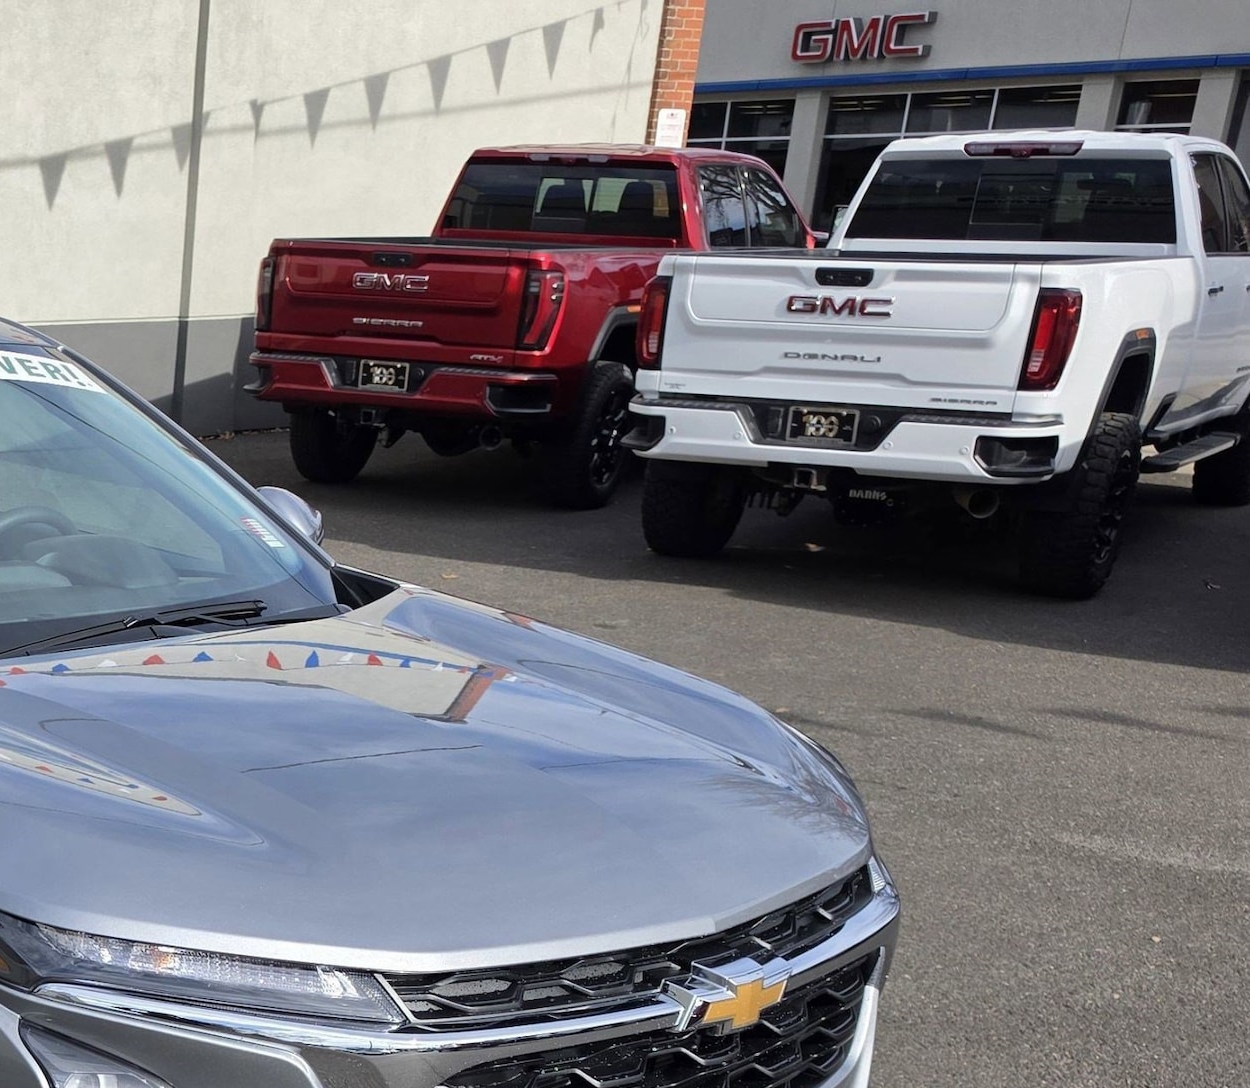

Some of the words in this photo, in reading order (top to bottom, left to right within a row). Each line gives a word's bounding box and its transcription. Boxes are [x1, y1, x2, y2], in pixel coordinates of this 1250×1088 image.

[791, 11, 932, 63] GMC
[353, 272, 429, 292] GMC
[786, 295, 896, 317] GMC
[783, 351, 882, 363] DENALI
[803, 414, 839, 437] 100
